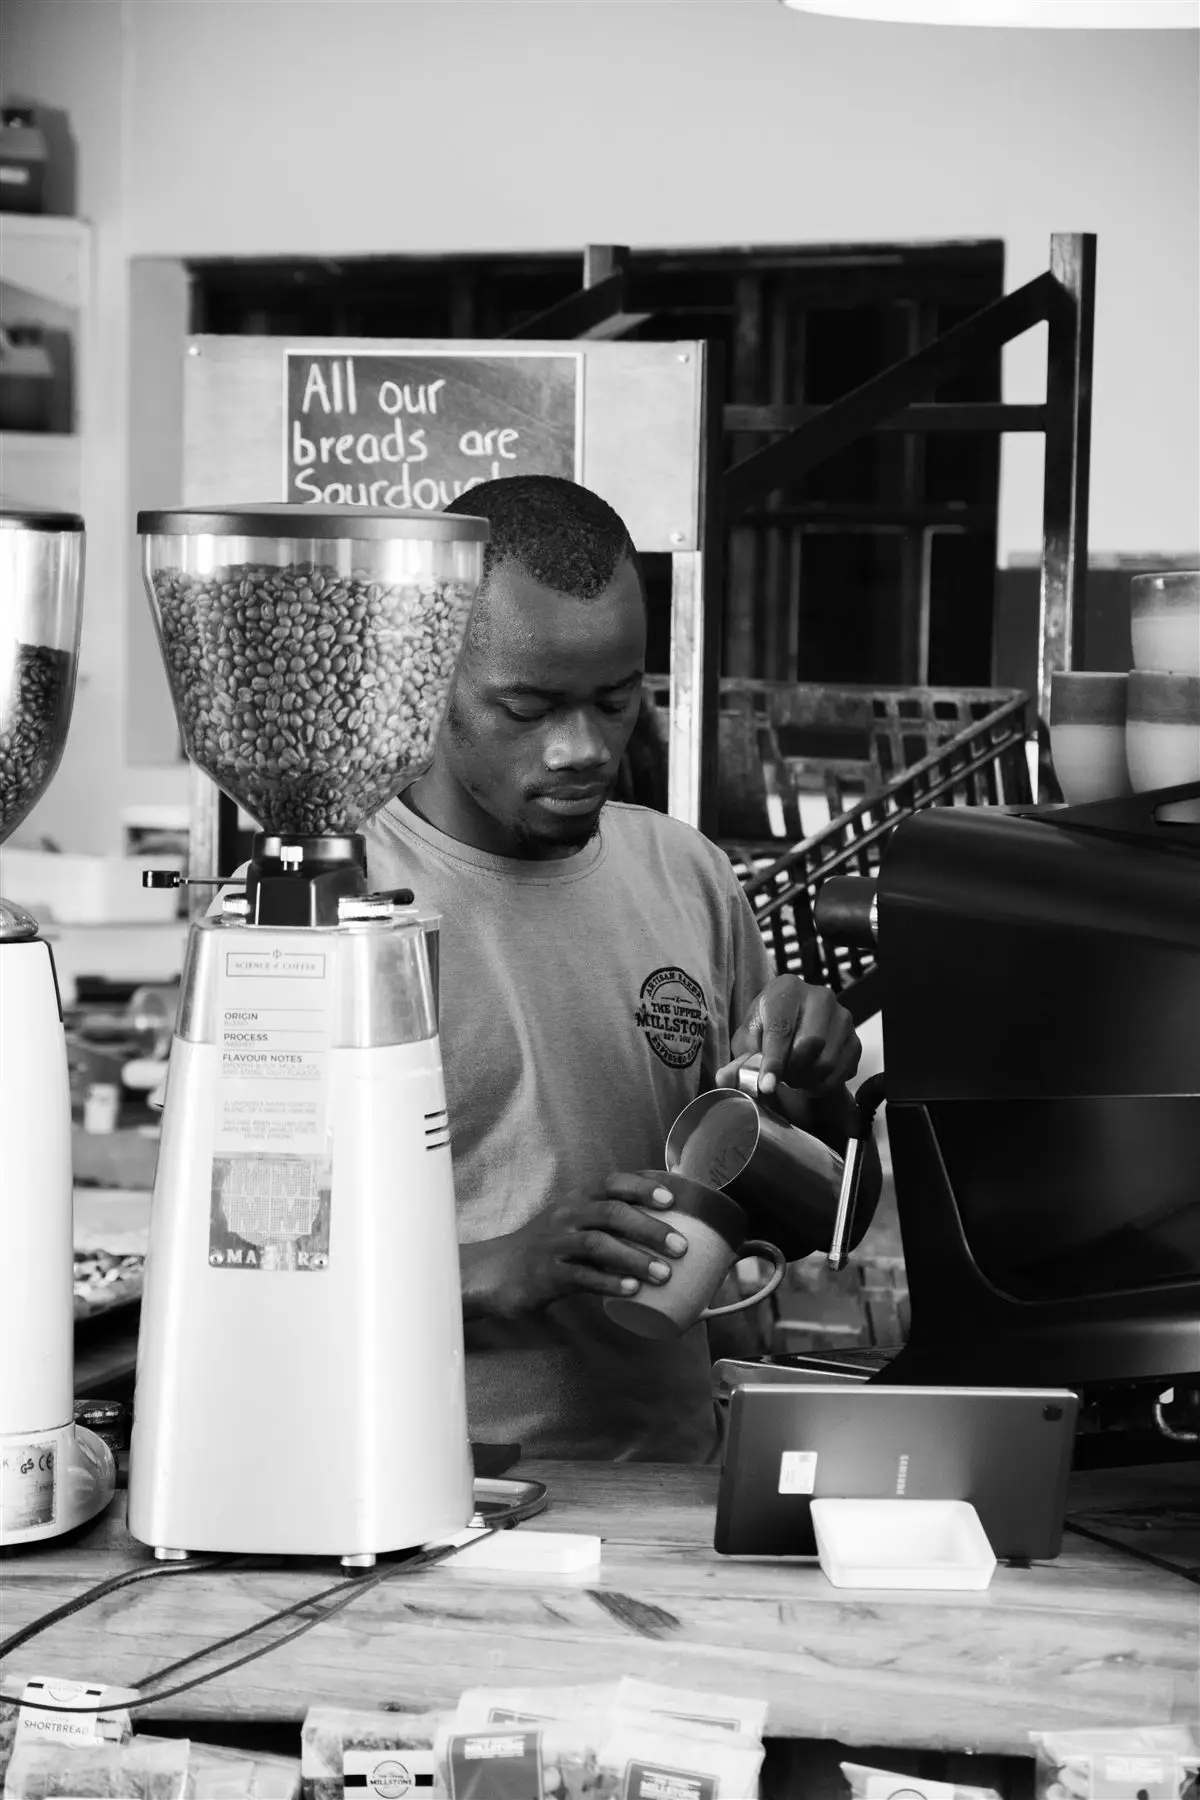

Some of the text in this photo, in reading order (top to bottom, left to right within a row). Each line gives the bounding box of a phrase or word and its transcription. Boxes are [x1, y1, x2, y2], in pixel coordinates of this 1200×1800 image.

[302, 356, 446, 415] All our
[293, 417, 519, 465] breads are
[294, 461, 500, 510] Sourdou
[645, 972, 675, 997] ARTISAN
[224, 1012, 258, 1020] ORIGIN
[651, 1002, 701, 1020] THE UPPER
[635, 1012, 706, 1039] MILLSTON
[223, 1033, 268, 1041] PROCESS
[222, 1054, 303, 1063] FLAVOUR NOTES
[24, 1720, 89, 1735] SHORTBREAD
